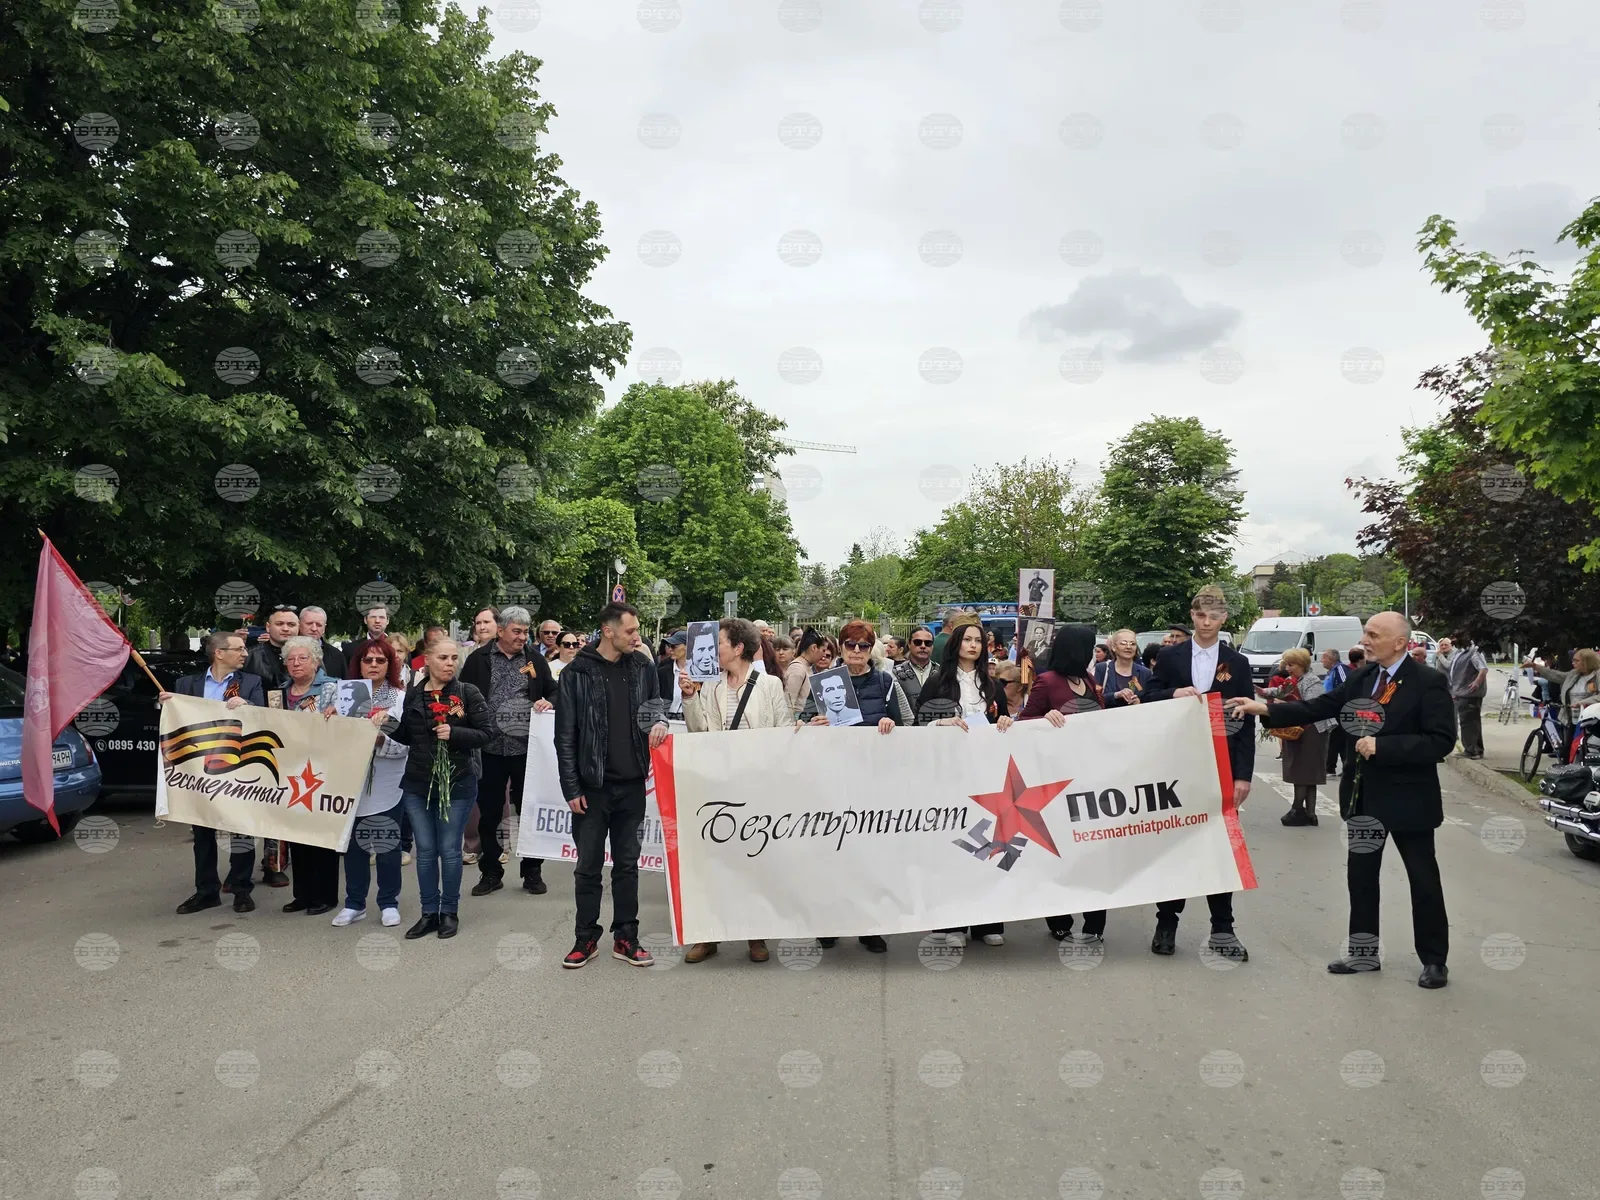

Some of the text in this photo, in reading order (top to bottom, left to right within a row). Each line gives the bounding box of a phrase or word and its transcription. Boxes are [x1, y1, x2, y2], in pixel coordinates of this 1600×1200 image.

[108, 740, 156, 751] 0895 430
[696, 801, 968, 857] Безсмъртният
[1073, 812, 1208, 843] bezsmartniatpolk.com
